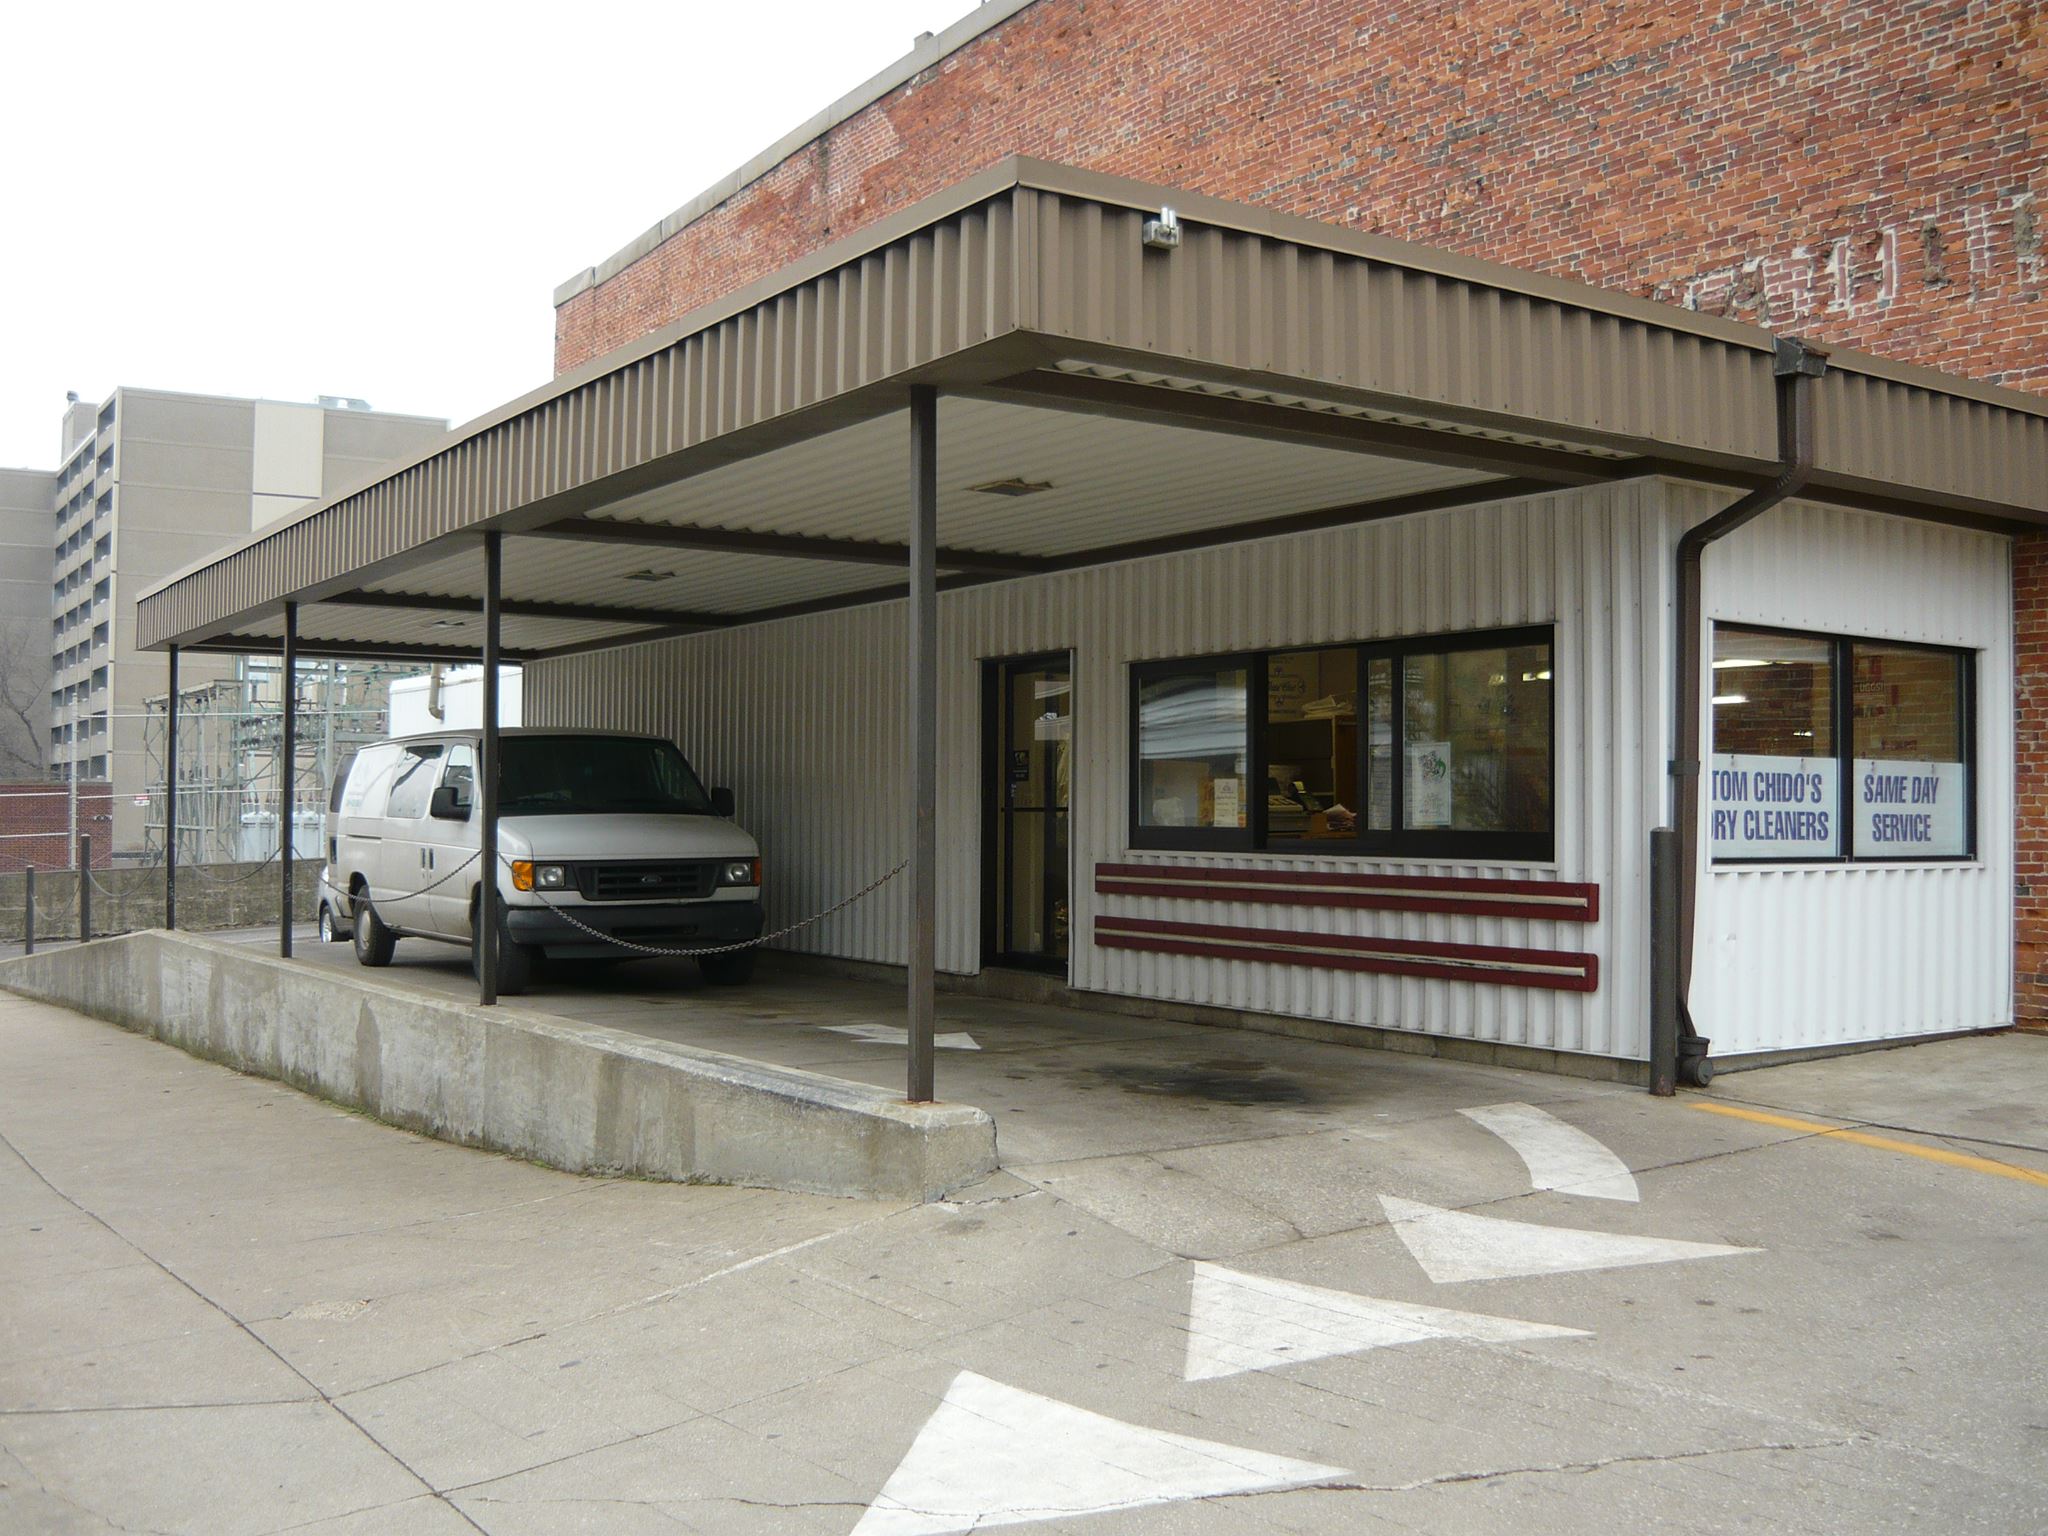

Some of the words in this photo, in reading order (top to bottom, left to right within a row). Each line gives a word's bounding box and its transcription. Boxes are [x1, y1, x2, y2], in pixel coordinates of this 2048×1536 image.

[1712, 770, 1748, 801] TOM
[1753, 771, 1822, 804] CHIDO'S
[1863, 774, 1907, 804] SAME
[1911, 776, 1939, 804] DAY
[1712, 809, 1737, 840] RY
[1743, 810, 1829, 841] CLEANERS
[1872, 813, 1932, 842] SERVICE
